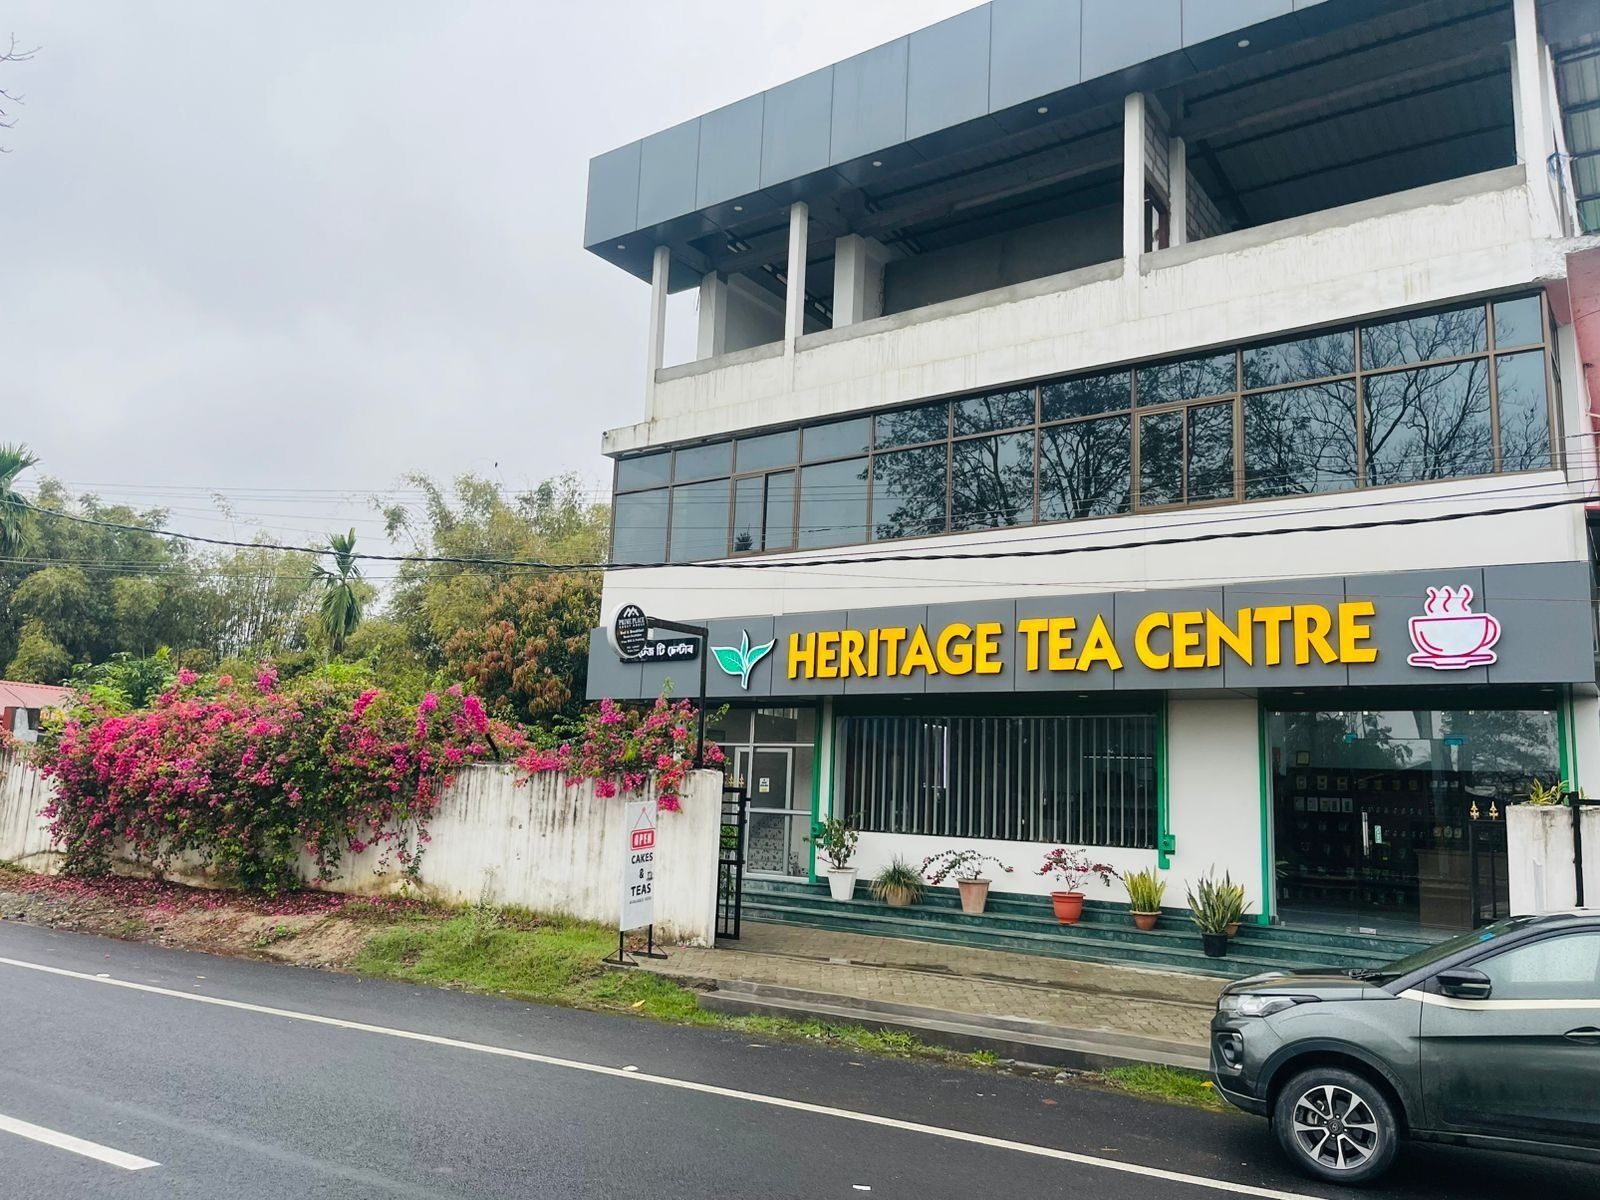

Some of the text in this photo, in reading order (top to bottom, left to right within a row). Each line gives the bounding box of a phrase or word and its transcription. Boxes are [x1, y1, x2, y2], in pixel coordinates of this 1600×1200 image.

[787, 601, 1378, 679] HERITAGE TEA CENTRE
[633, 833, 652, 846] OPEN
[631, 852, 653, 864] CAKES
[639, 868, 644, 879] &
[631, 883, 652, 896] TEAS
